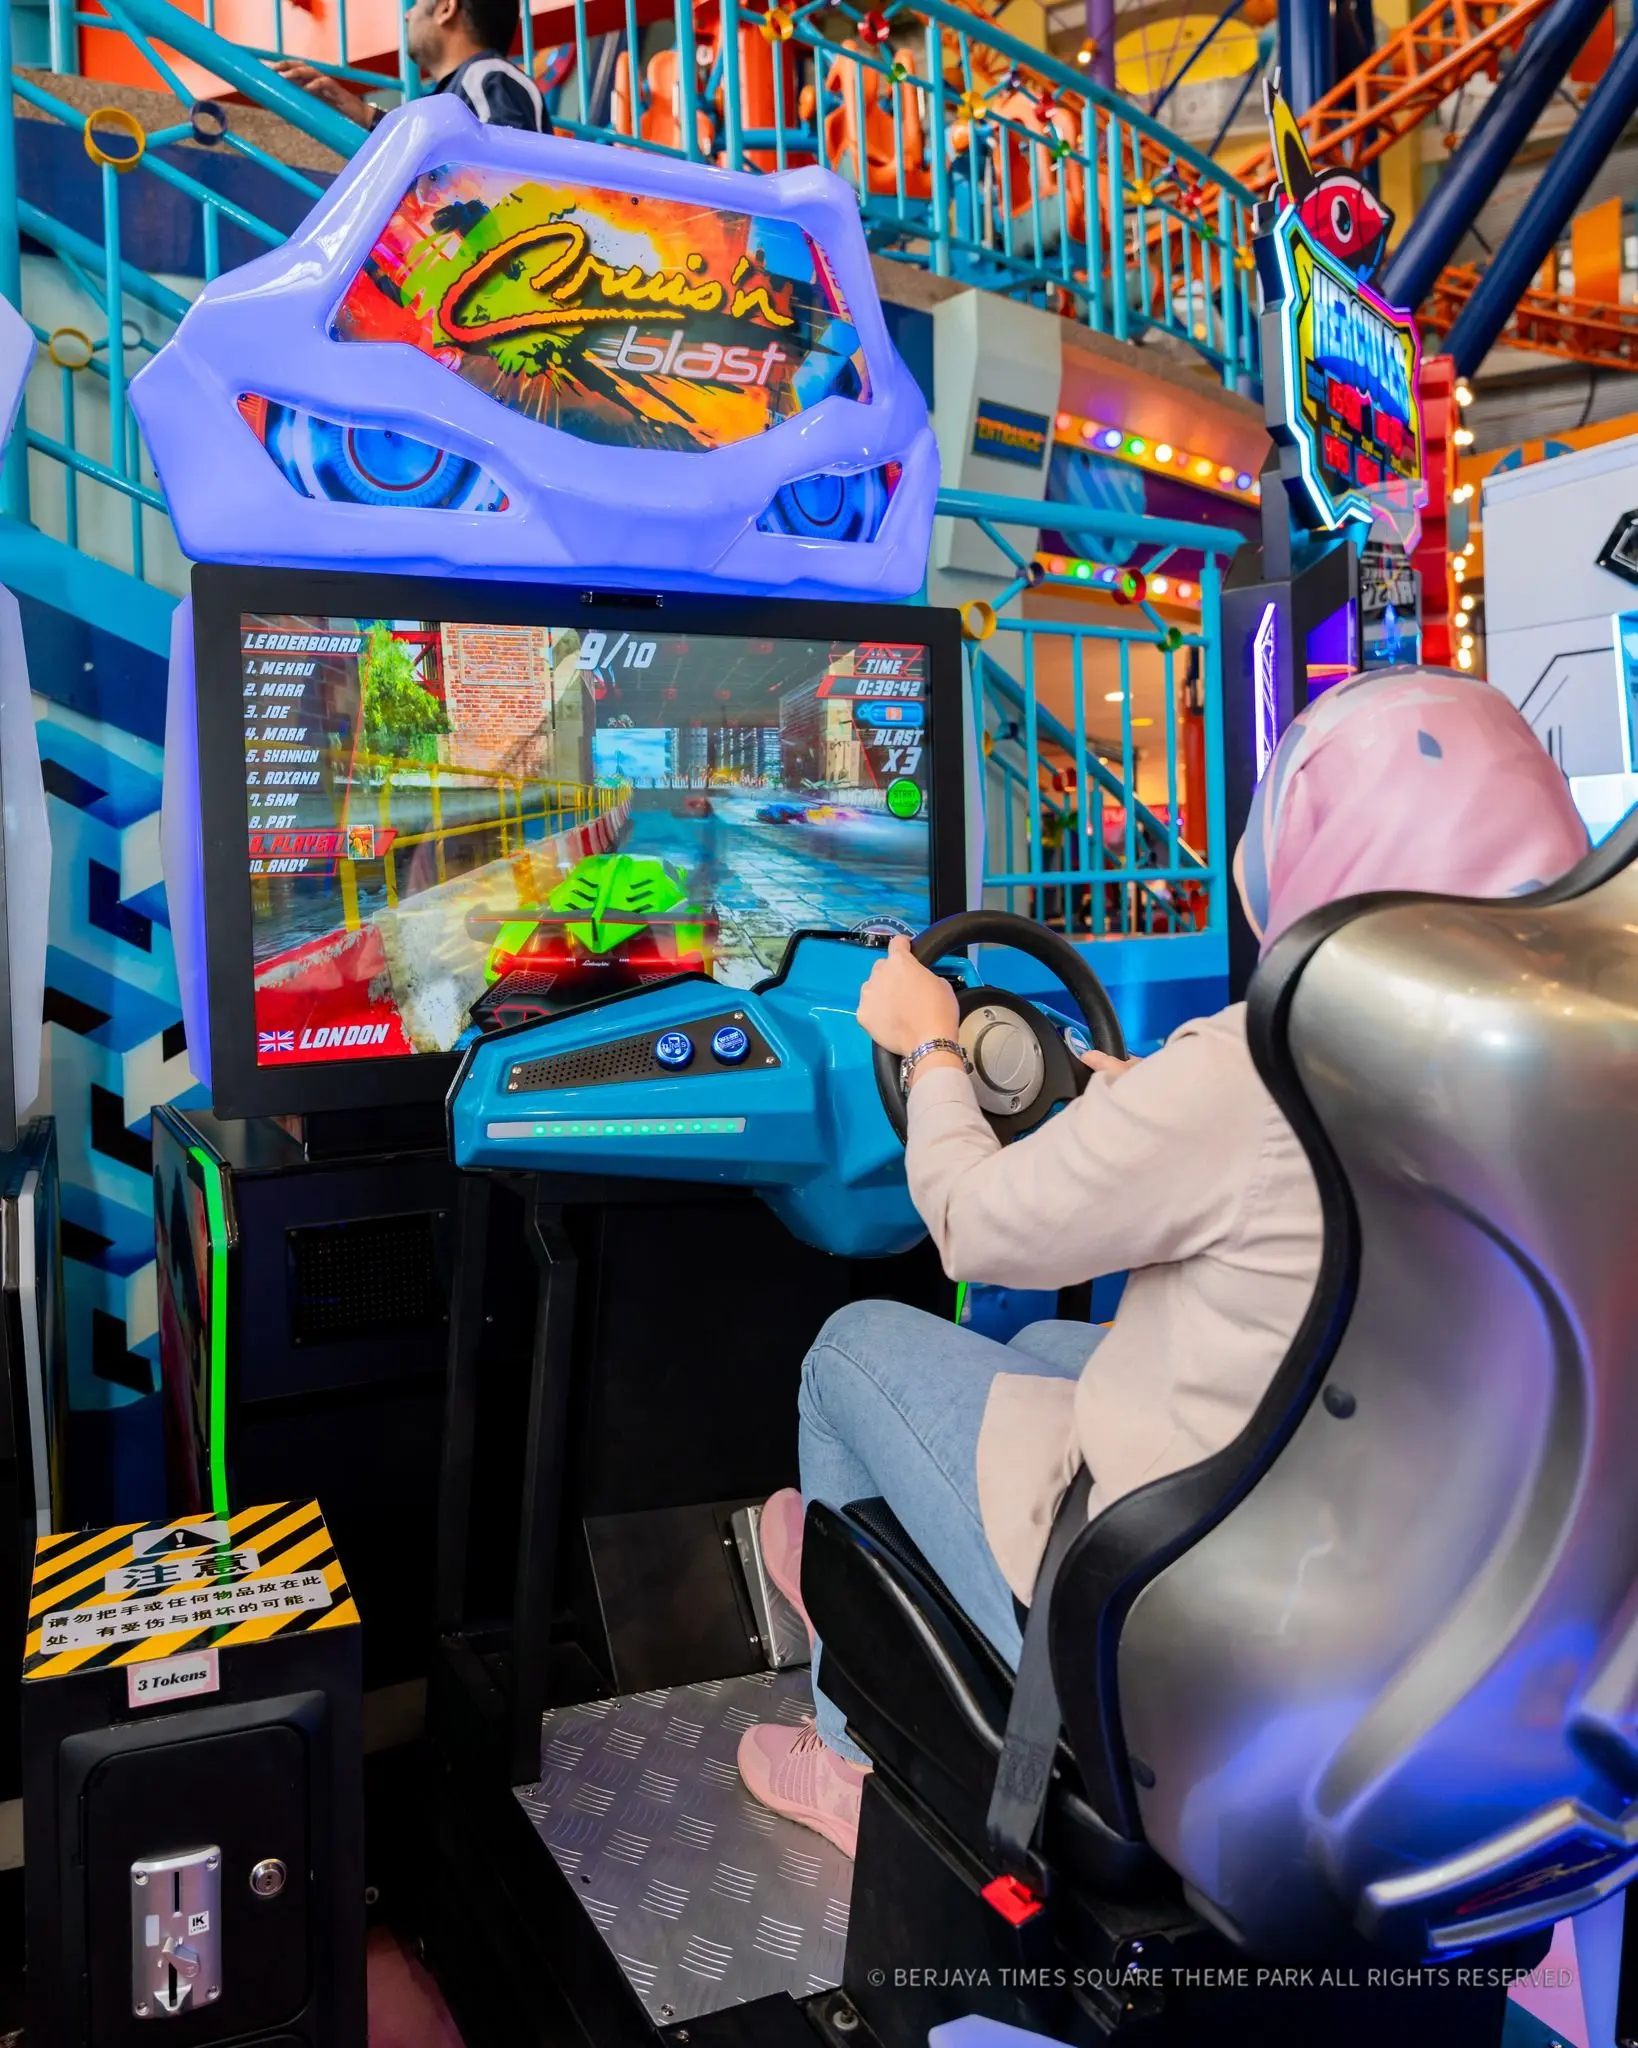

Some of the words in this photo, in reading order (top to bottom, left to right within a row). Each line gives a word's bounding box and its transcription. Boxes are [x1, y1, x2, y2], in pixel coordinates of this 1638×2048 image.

[616, 325, 787, 385] blast
[244, 633, 361, 653] LEADERBOARD
[575, 632, 657, 670] 9/10
[246, 660, 257, 675] 1.
[866, 659, 903, 675] TIME
[243, 682, 258, 697] 2.
[856, 679, 921, 697] 0:39:42
[244, 704, 259, 719] 3.
[261, 705, 291, 719] JOE
[245, 727, 260, 740] 4.
[262, 727, 308, 741] MARK
[873, 729, 925, 747] BLAST
[245, 749, 260, 763] 5.
[262, 749, 320, 763] SHANNON
[882, 748, 922, 775] X3
[246, 771, 261, 785] 6.
[263, 771, 321, 785] ROXANA
[250, 793, 262, 807] 7.
[264, 793, 300, 807] SAM
[248, 815, 262, 829] 8.
[265, 815, 297, 829] PAT
[249, 859, 264, 873] 10.
[266, 859, 310, 873] ANDY
[299, 1024, 390, 1050] LONDON
[123, 1553, 250, 1590] 注意
[47, 1575, 322, 1629] 请勿把手或任何物品放在此
[138, 1679, 148, 1692] 3
[151, 1668, 208, 1689] Tokens
